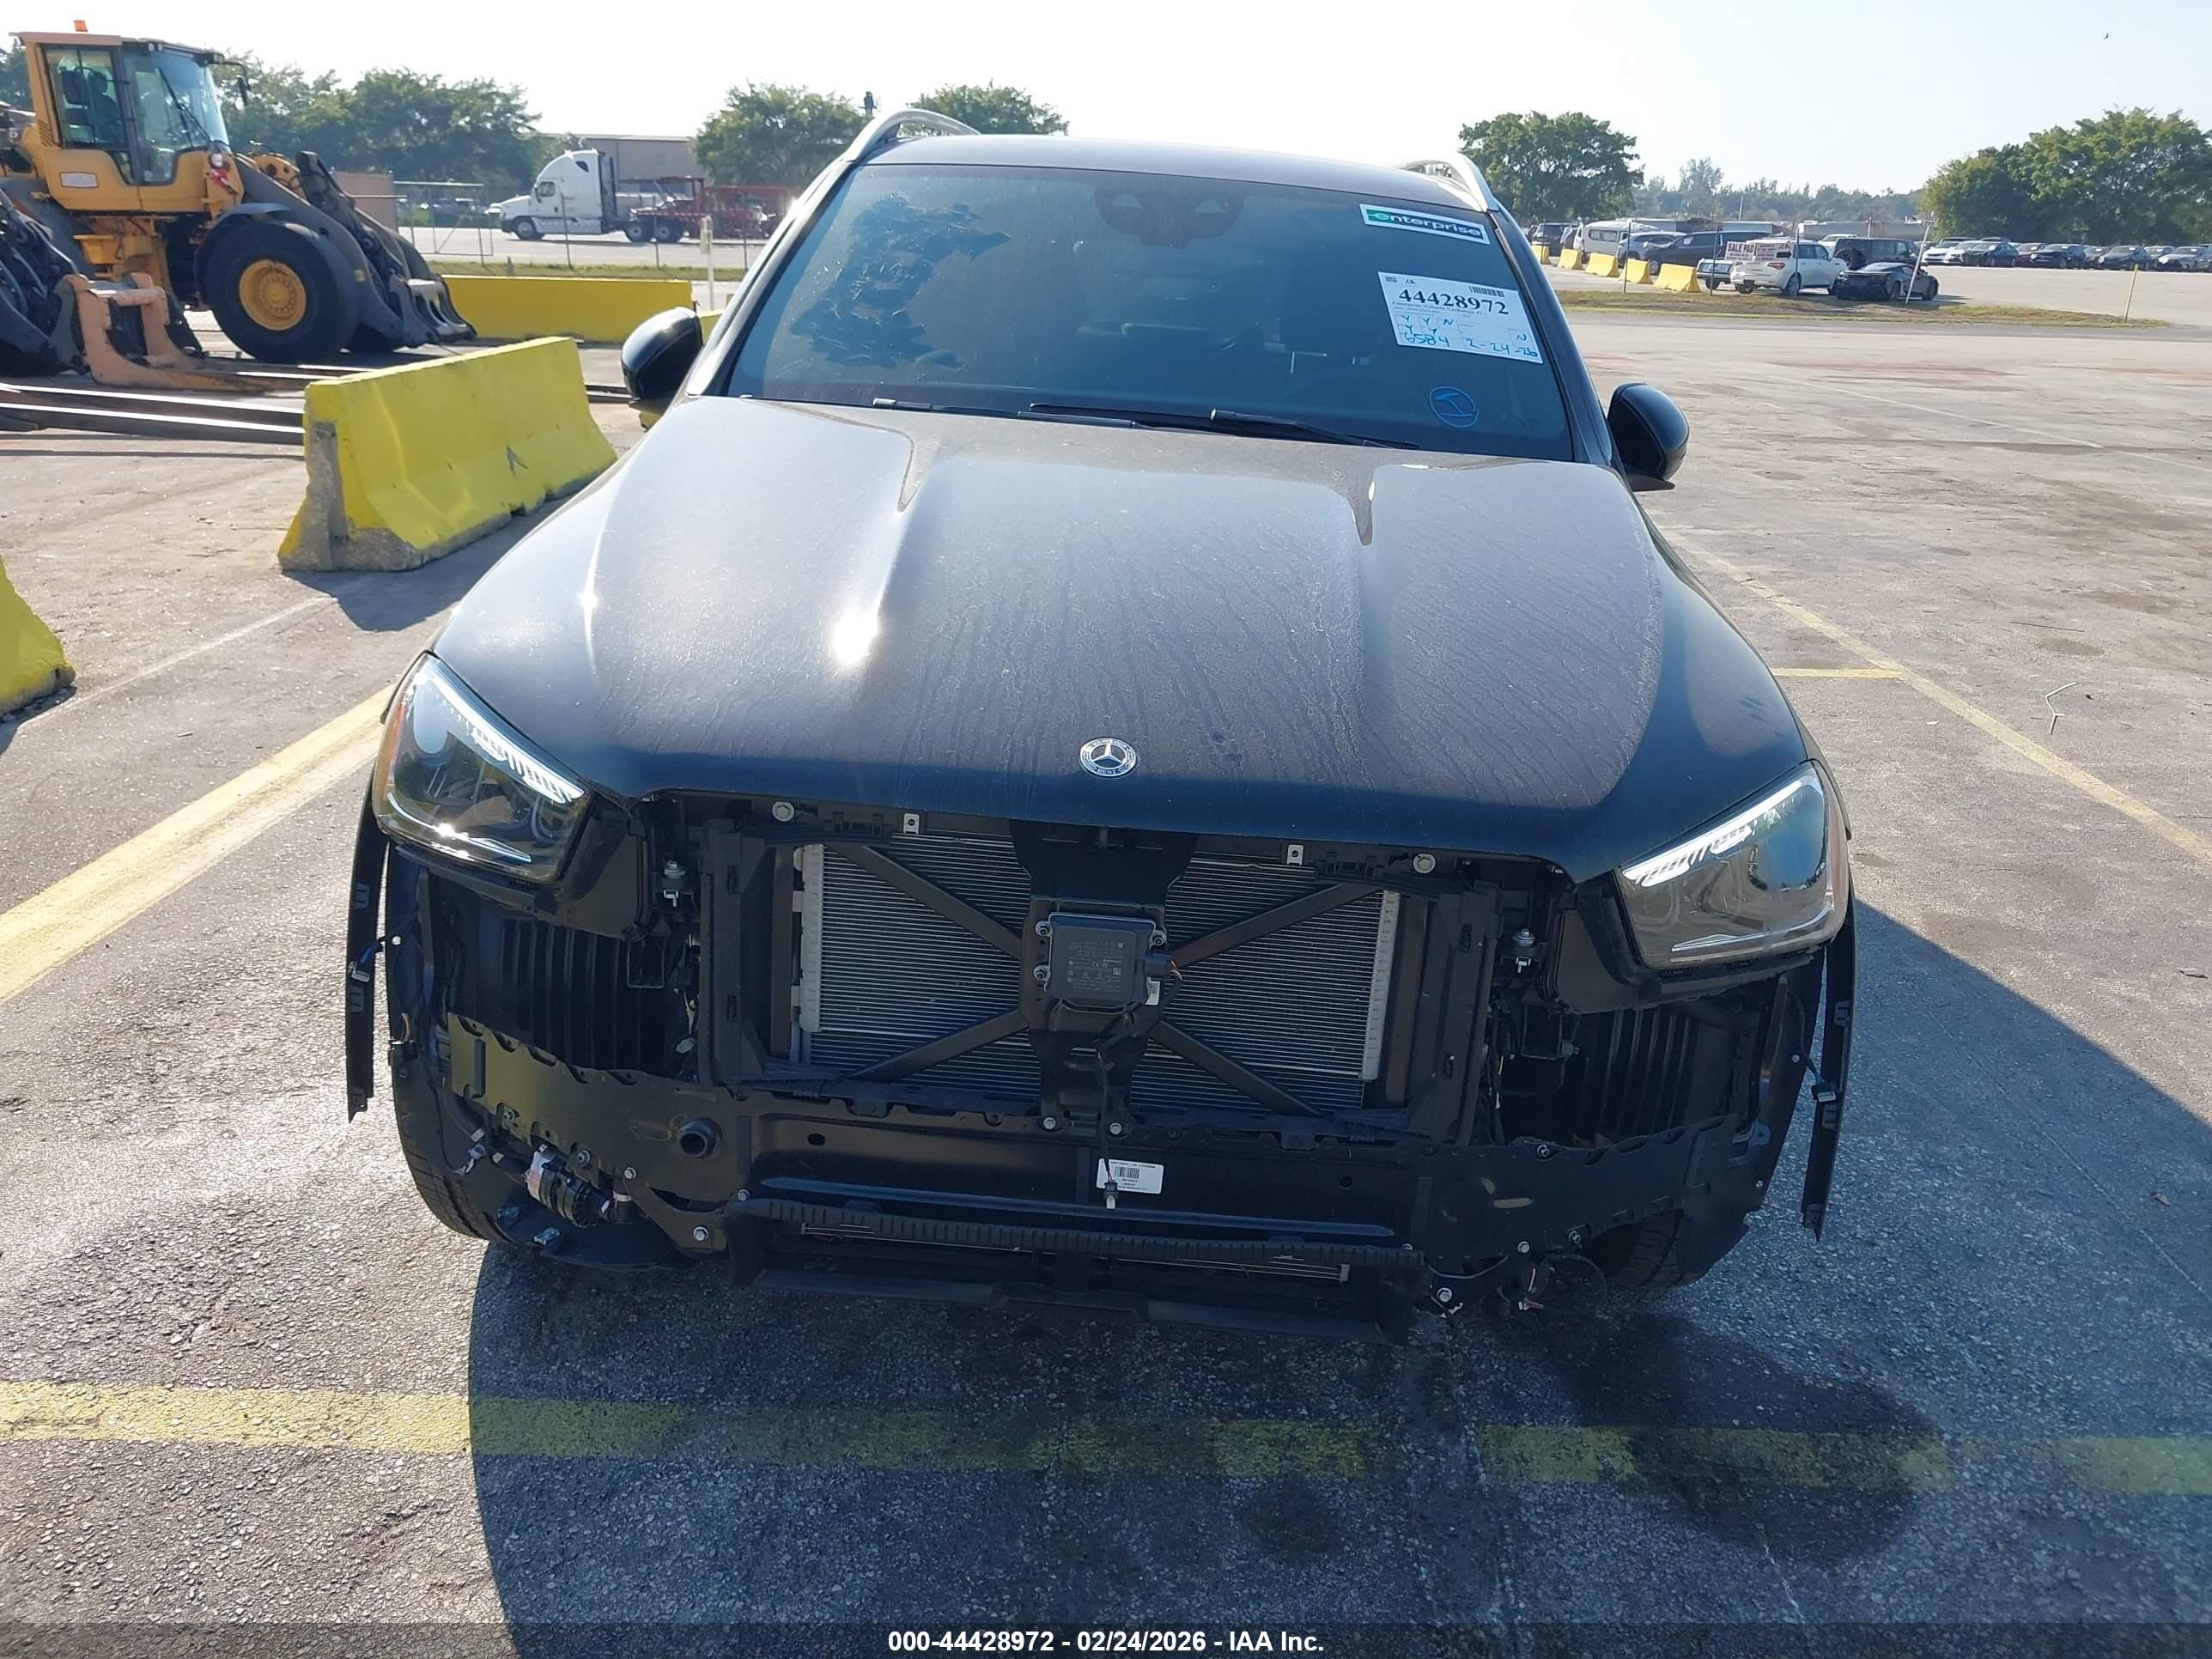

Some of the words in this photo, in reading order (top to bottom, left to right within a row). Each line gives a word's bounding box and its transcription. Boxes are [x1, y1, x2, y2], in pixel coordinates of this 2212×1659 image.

[1373, 213, 1481, 236] enterprise
[1728, 243, 1742, 252] SALE
[1744, 244, 1754, 253] PAD
[1399, 289, 1509, 315] 44428972
[1404, 332, 1450, 348] 6584
